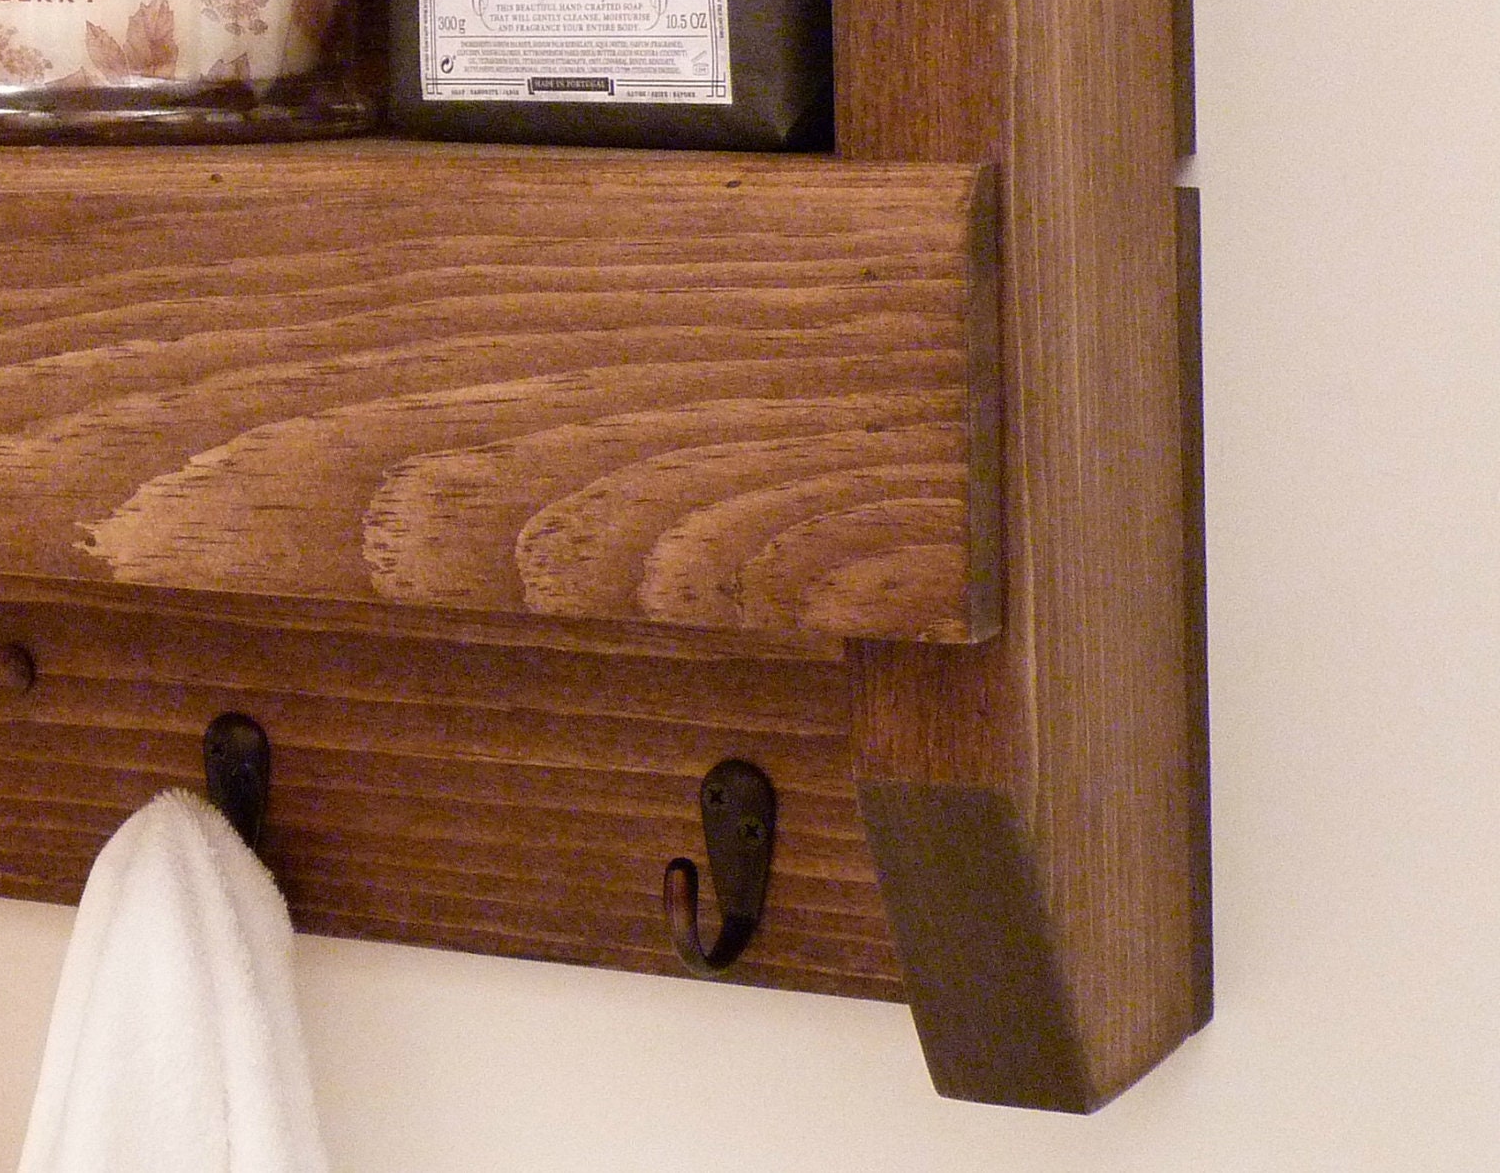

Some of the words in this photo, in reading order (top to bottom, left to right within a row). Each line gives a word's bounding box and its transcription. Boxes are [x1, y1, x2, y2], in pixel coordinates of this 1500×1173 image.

[496, 4, 513, 12] THIS
[515, 3, 557, 12] BEAUTIFUL
[490, 14, 509, 22] THAT
[532, 14, 560, 22] GENTLY
[603, 13, 650, 21] MOISTURISE
[666, 14, 687, 29] 10.5
[690, 12, 708, 29] OZ
[516, 24, 560, 32] FRAGRANCE
[563, 24, 584, 32] YOUR
[586, 24, 615, 32] ENTIRE
